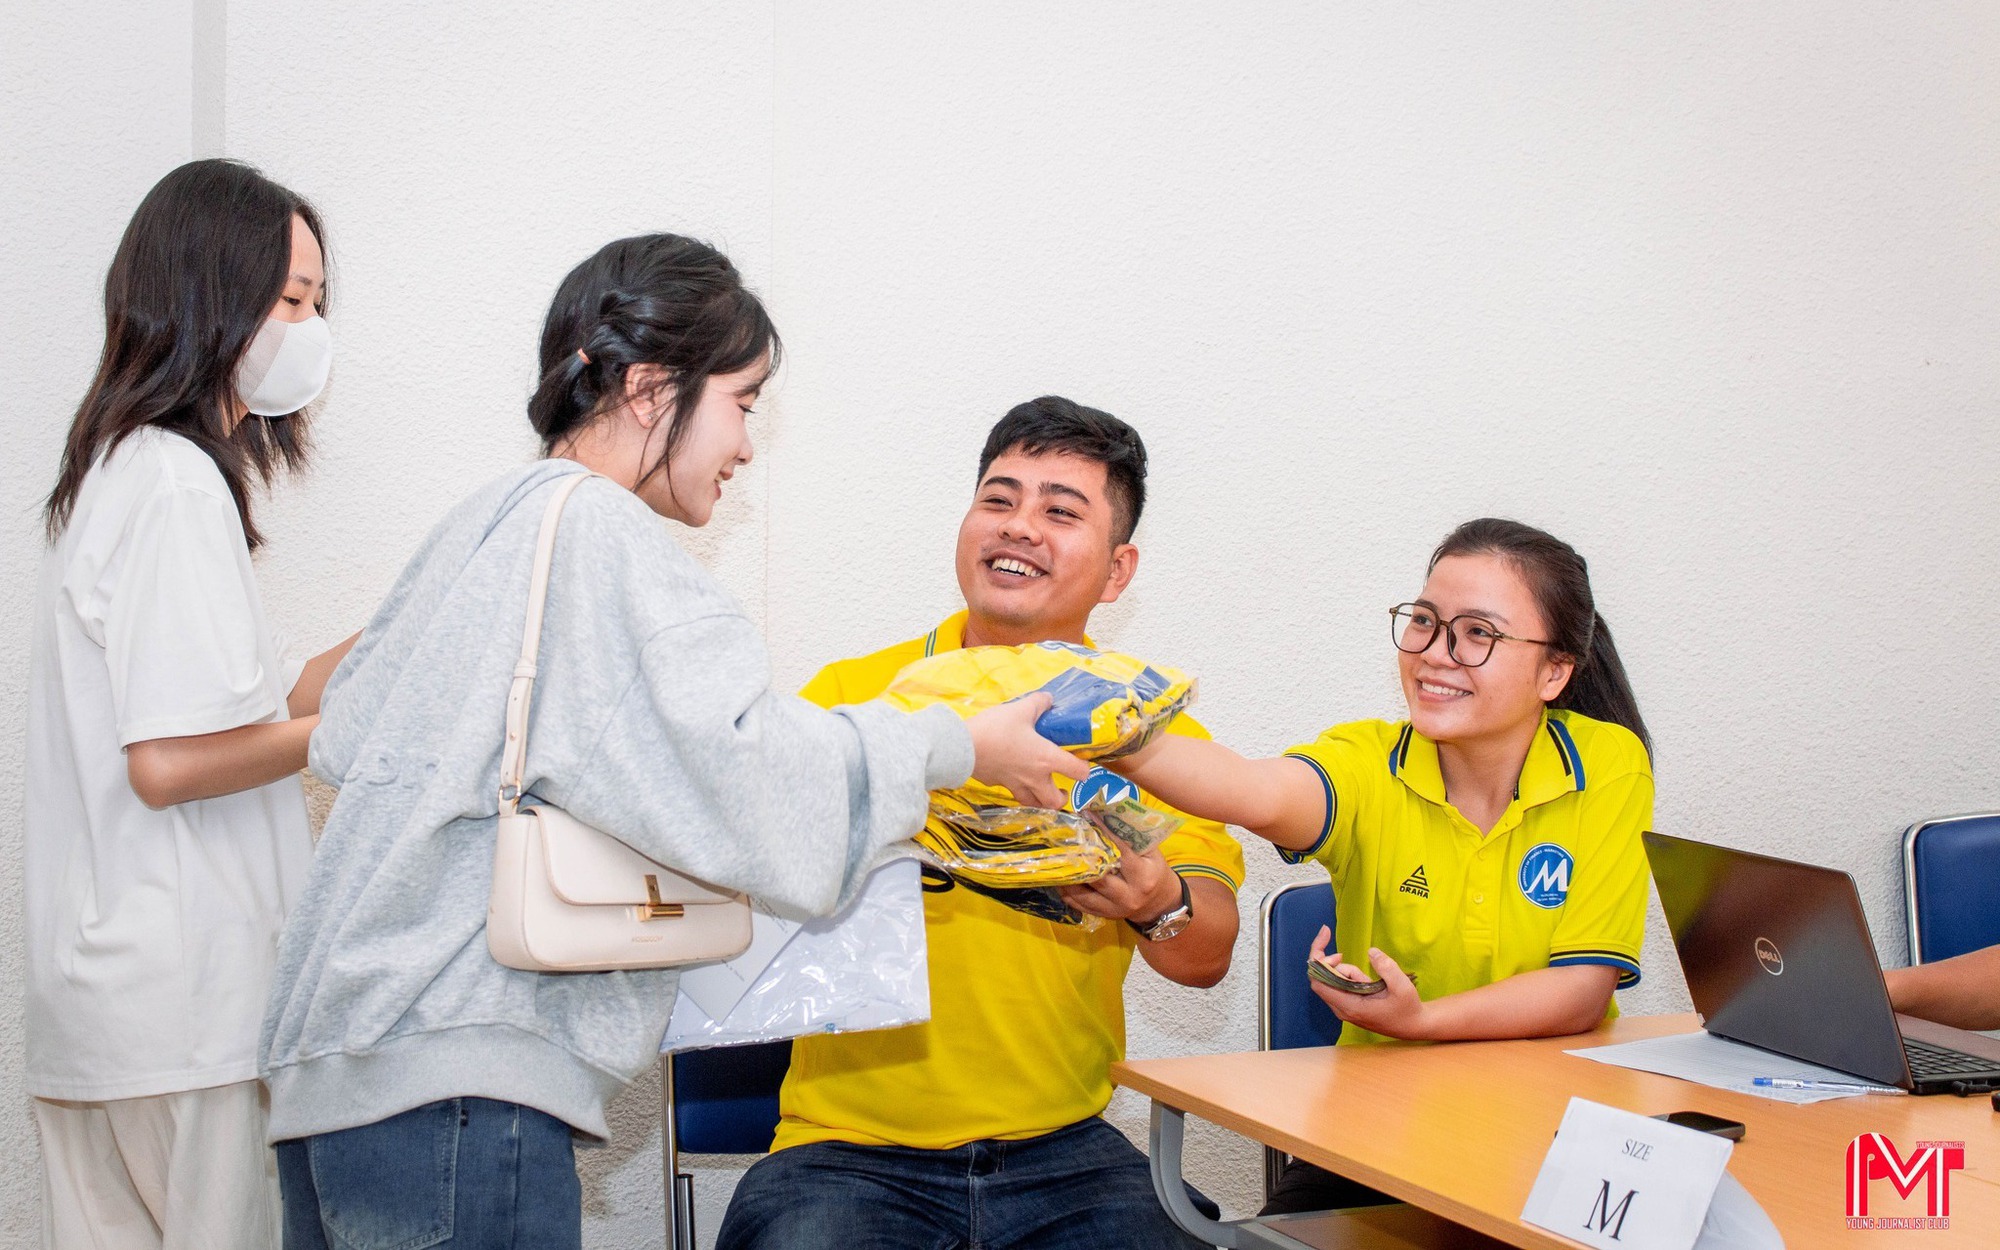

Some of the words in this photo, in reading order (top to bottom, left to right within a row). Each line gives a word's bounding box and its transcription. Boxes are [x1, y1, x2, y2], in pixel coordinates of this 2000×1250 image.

[1075, 782, 1085, 805] UNIVERSITY
[1525, 858, 1569, 894] M
[1399, 885, 1429, 899] DRAHA
[1758, 949, 1781, 964] DELL
[1621, 1138, 1654, 1161] SIZE
[1582, 1178, 1640, 1241] M
